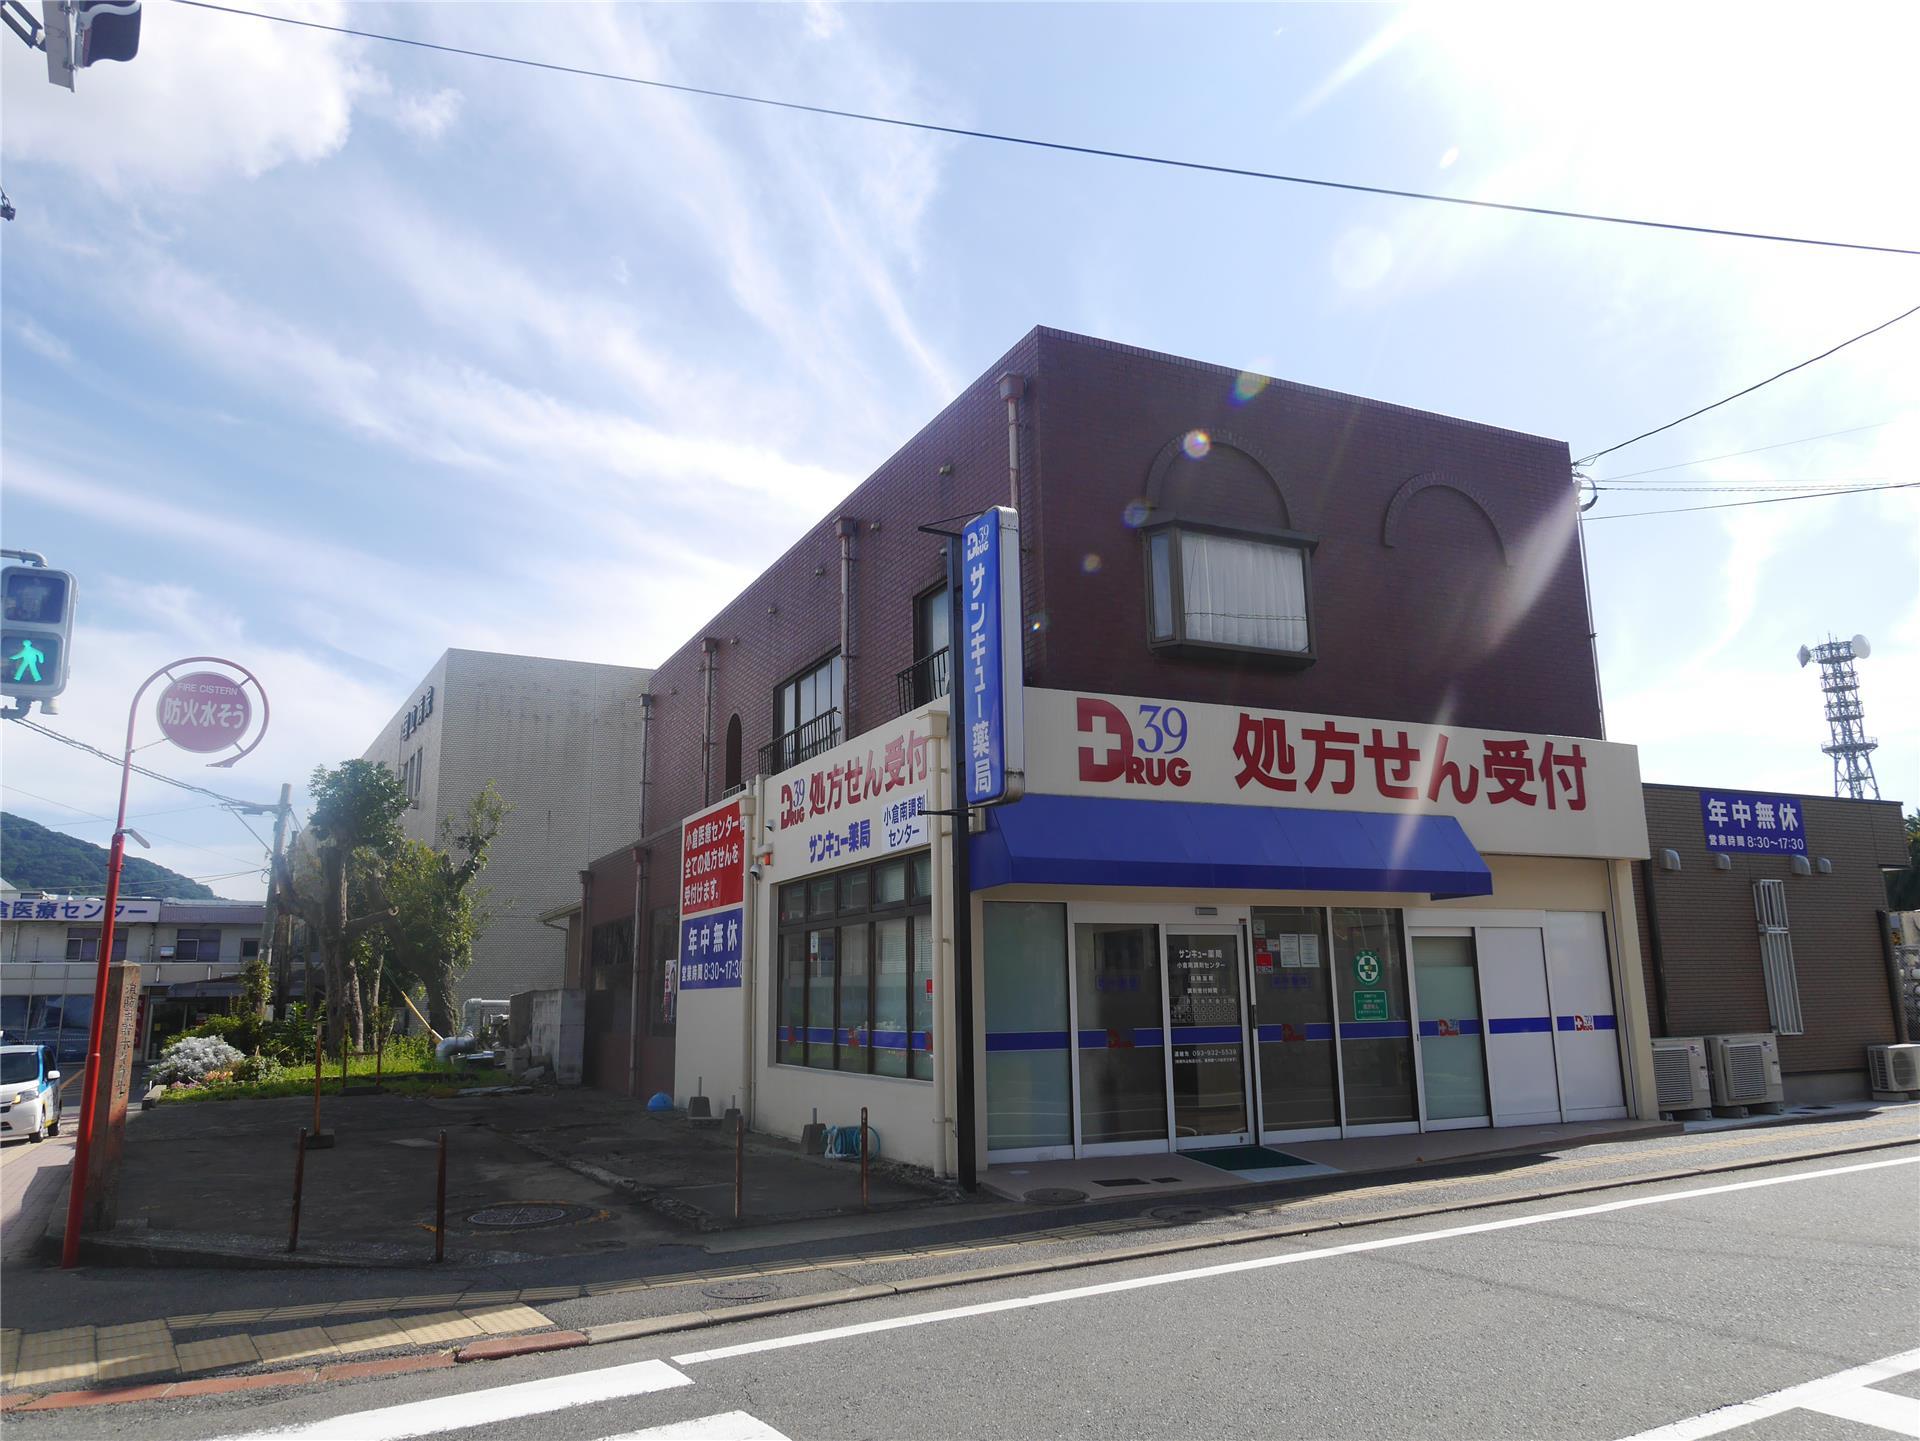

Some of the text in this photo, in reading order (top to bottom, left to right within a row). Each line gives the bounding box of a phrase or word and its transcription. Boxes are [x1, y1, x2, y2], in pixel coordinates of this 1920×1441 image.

[979, 524, 990, 543] 39
[176, 682, 239, 696] FIRE CISTERN
[970, 562, 992, 794] サンキュー薬局
[162, 697, 245, 729] 防火水そう
[1076, 697, 1192, 788] DRUG 39
[809, 730, 929, 818] 処方せん受付
[1232, 712, 1588, 811] 処方せん受付
[793, 778, 806, 807] 39
[883, 793, 926, 827] 小倉南調剤
[1707, 798, 1799, 831] 年中無休
[808, 818, 871, 864] サンキュー薬局
[888, 823, 920, 848] センター
[684, 842, 739, 879] 全ての処方せんを
[683, 878, 719, 906] 受付けます。
[687, 919, 738, 957] 年中無休
